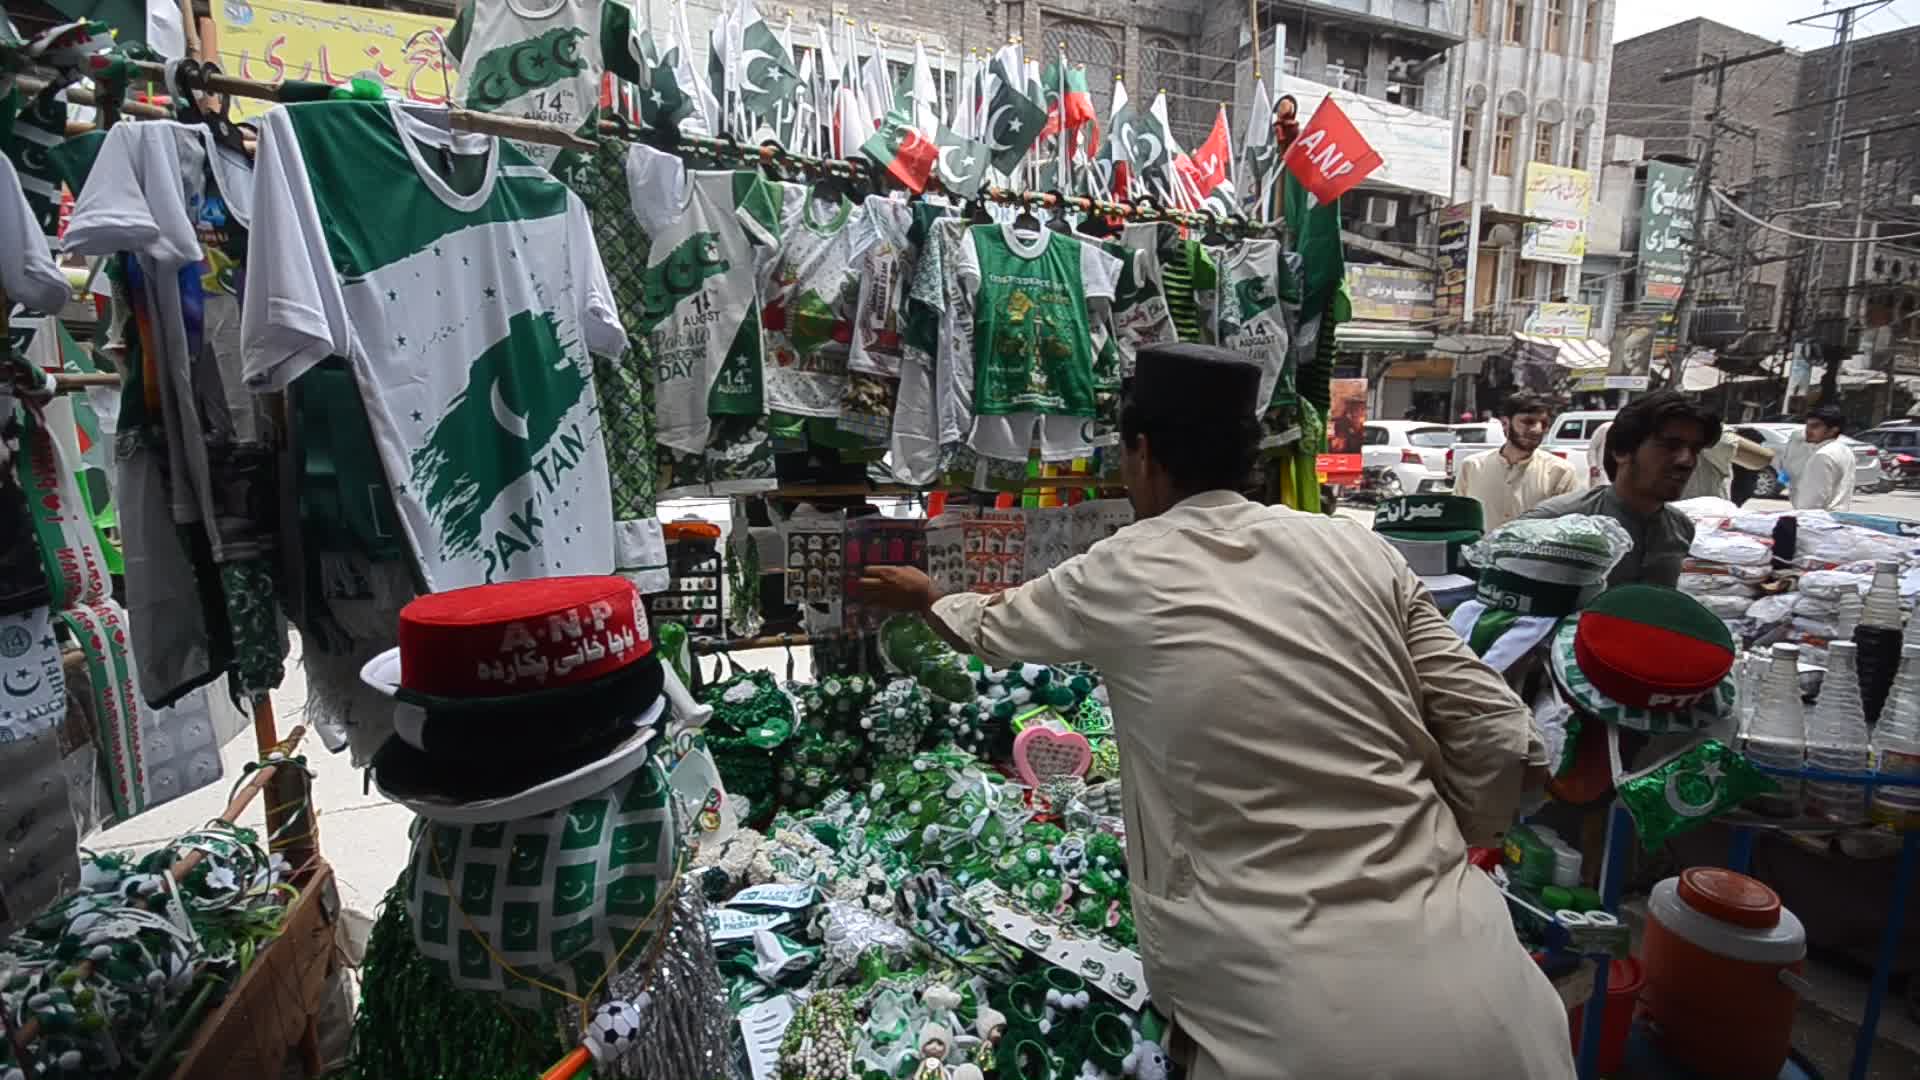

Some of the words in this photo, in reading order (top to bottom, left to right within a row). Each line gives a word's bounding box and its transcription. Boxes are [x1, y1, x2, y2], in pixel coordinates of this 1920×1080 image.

[523, 111, 572, 124] AUGUST
[1298, 129, 1354, 180] A.N.P
[658, 359, 694, 382] DAY
